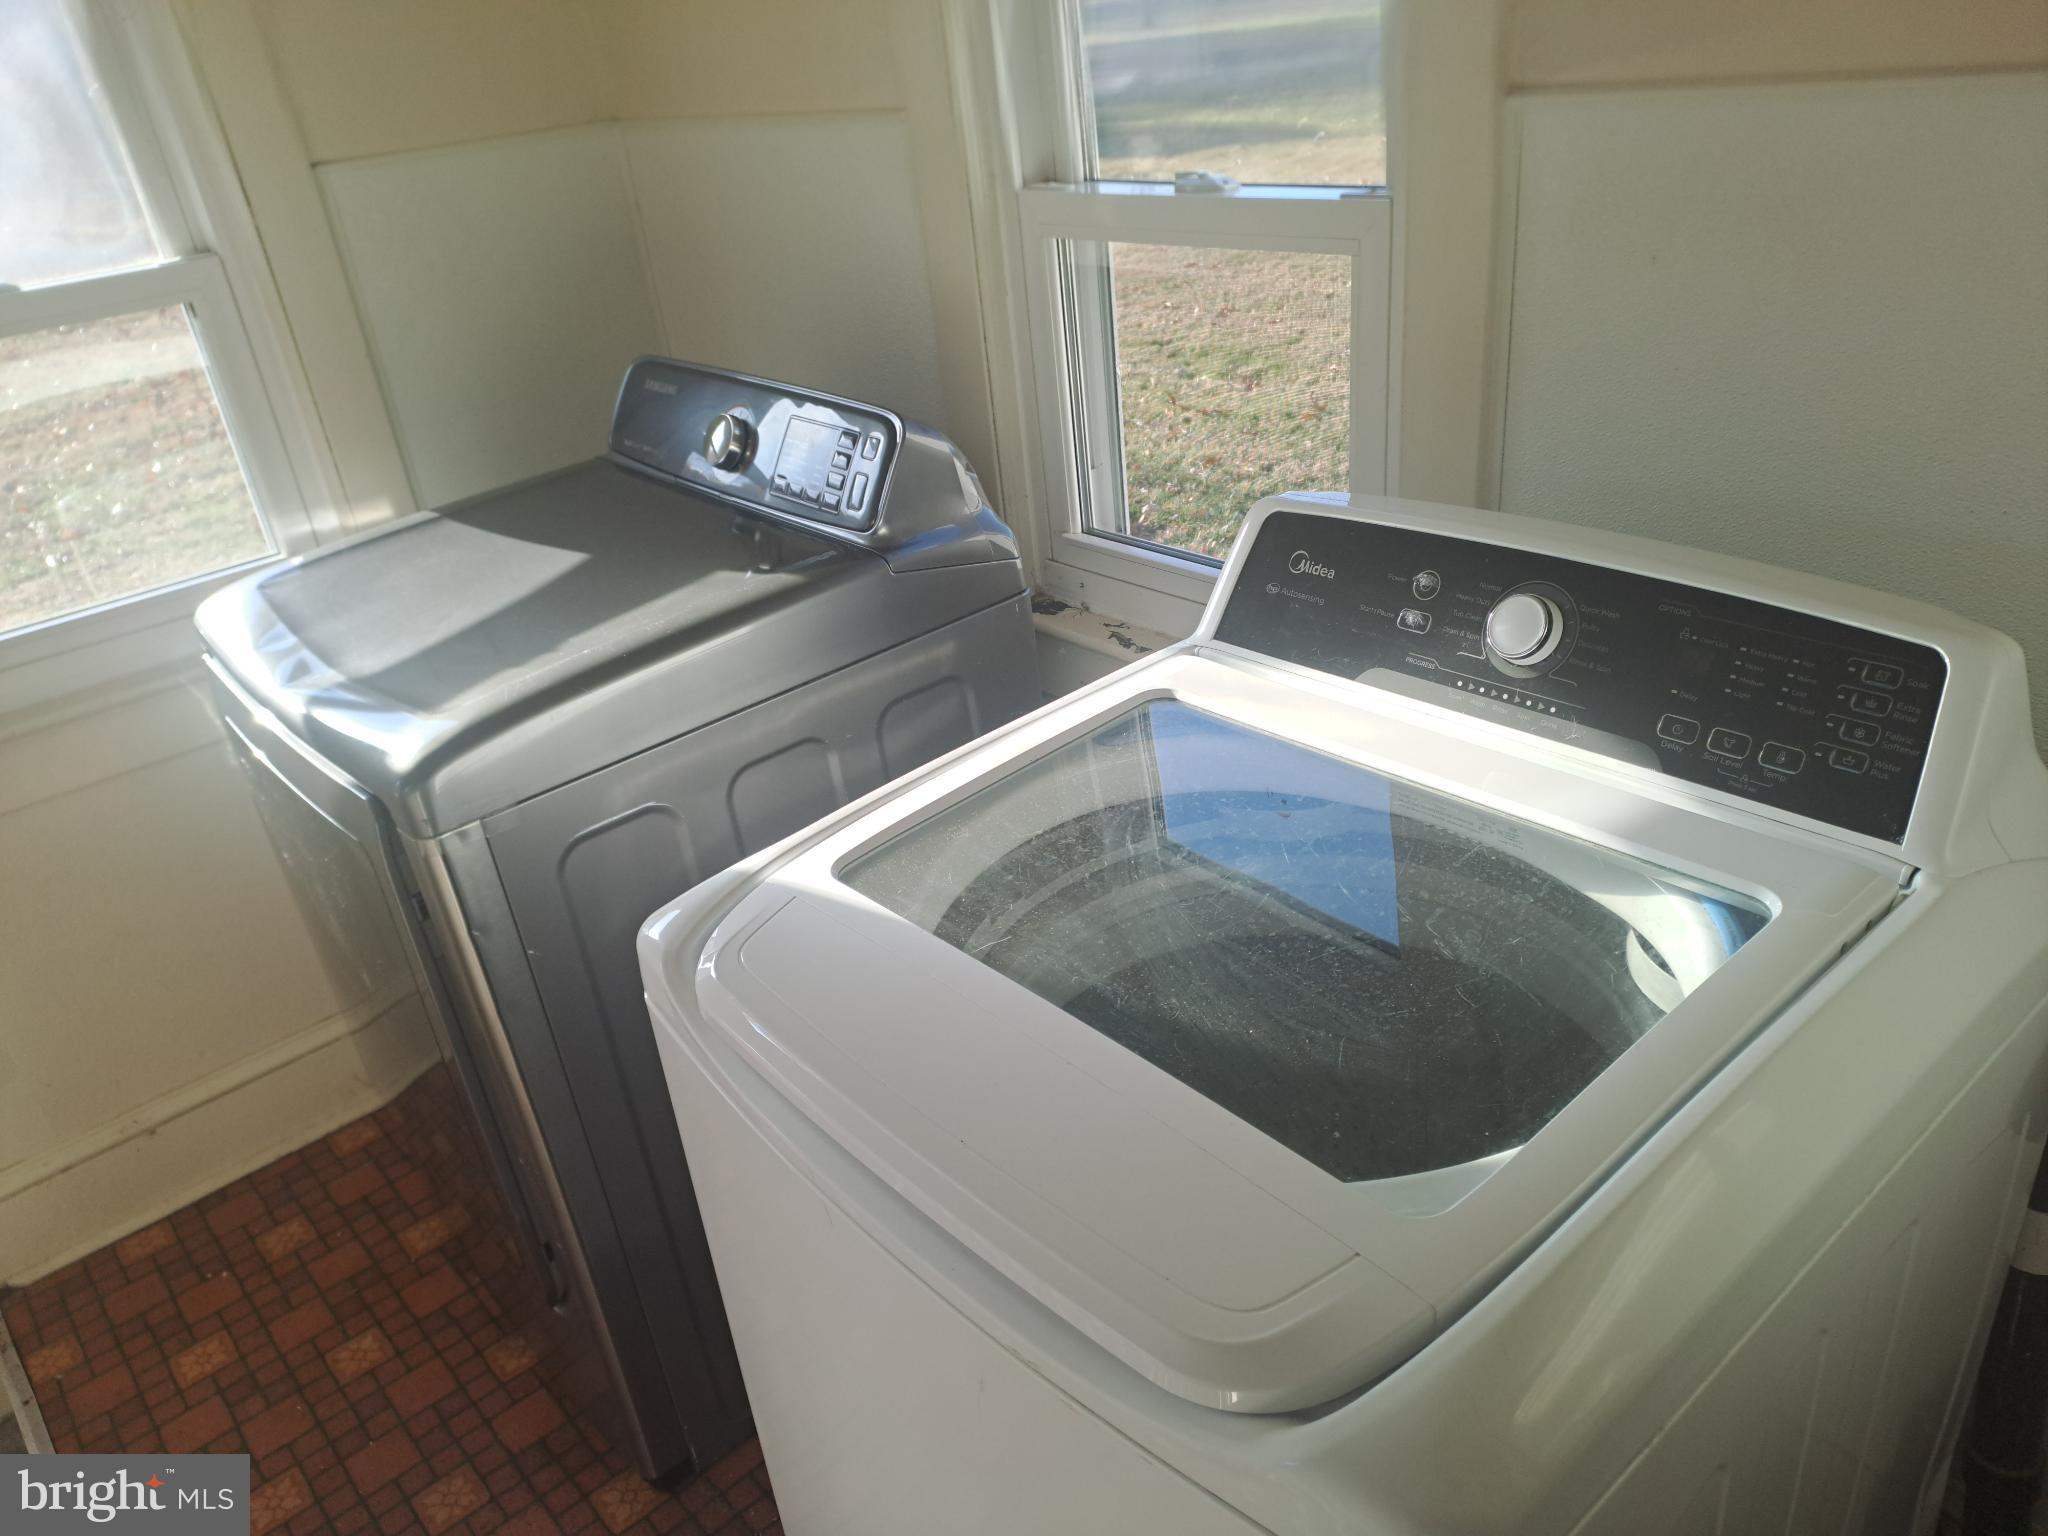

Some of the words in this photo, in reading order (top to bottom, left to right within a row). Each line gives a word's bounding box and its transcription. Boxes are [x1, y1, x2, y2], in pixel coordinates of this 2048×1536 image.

[1289, 550, 1336, 579] Midea
[1281, 586, 1325, 606] Autosensing
[1405, 656, 1436, 670] PROGRESS
[1660, 739, 1684, 753] Delay
[1703, 751, 1719, 763] Soil
[1720, 757, 1744, 769] Level
[1763, 768, 1787, 784] Temp
